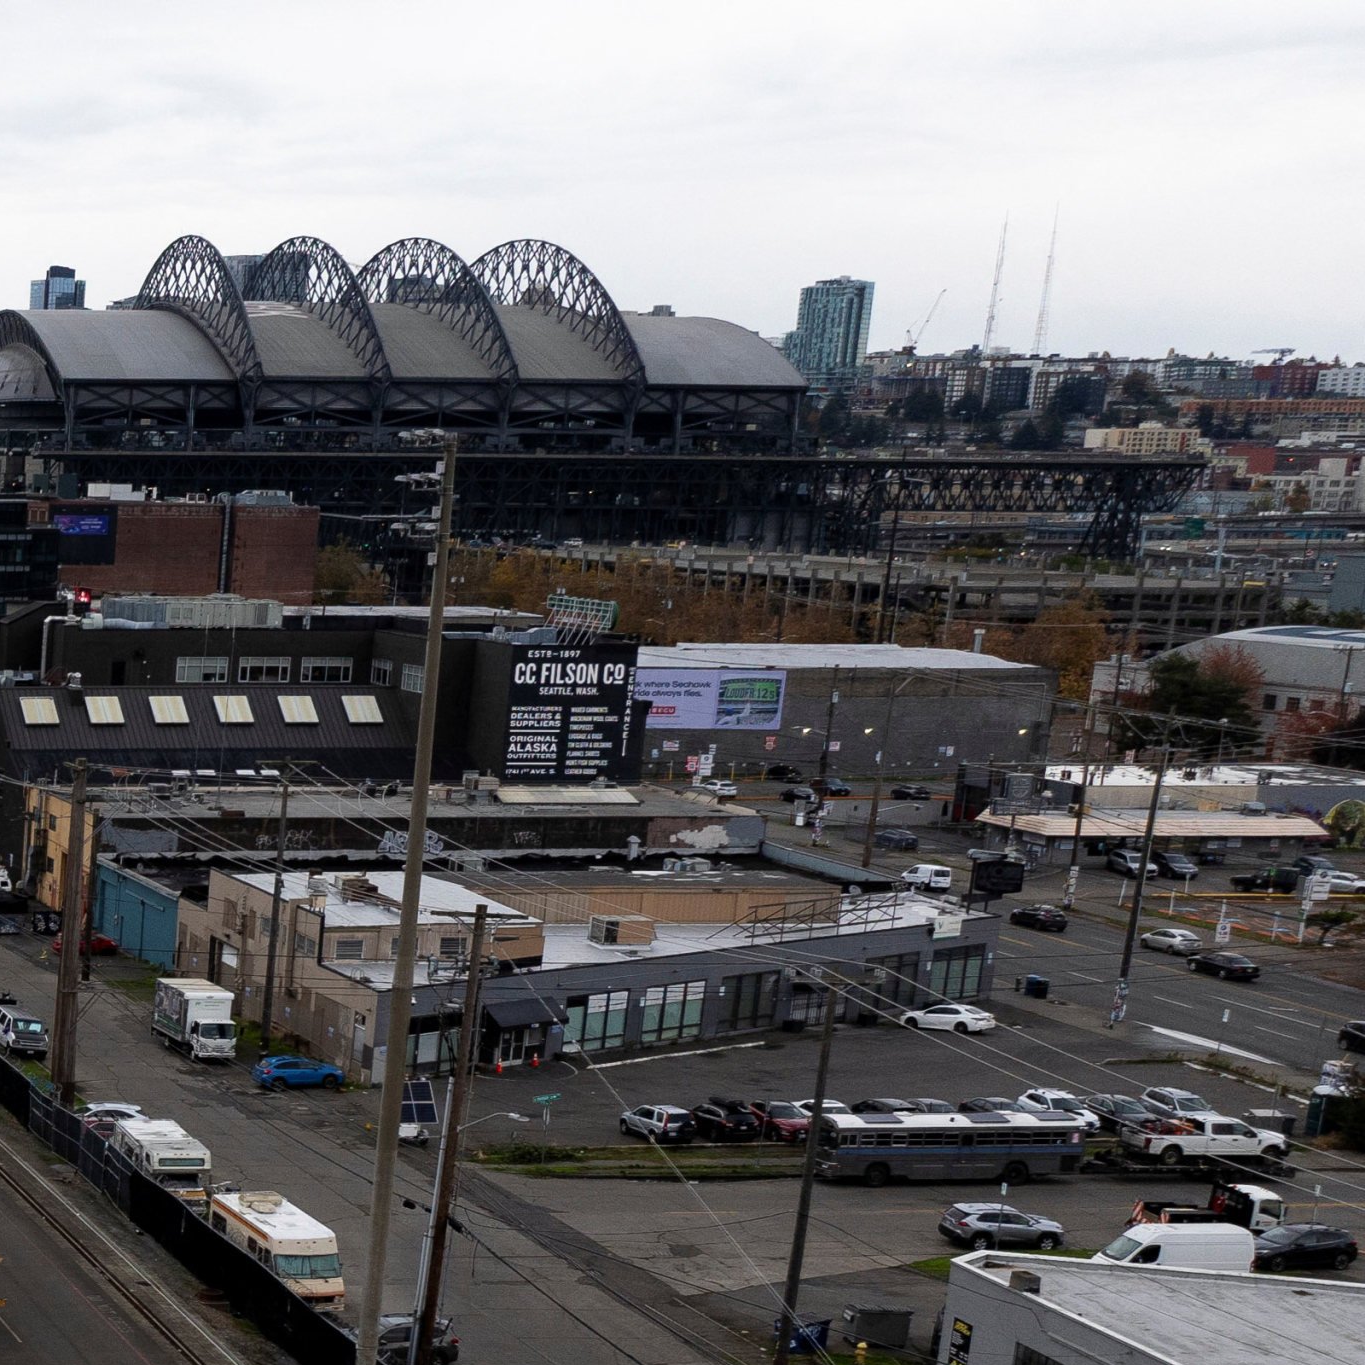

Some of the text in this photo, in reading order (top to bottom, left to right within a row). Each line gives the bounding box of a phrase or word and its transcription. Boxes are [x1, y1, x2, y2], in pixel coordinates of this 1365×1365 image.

[540, 662, 598, 684] FILSON
[539, 686, 600, 696] SEATTLE, WASH.
[651, 690, 682, 698] always
[622, 676, 636, 739] ENTRANCE
[510, 712, 562, 720] DEALERS &
[509, 735, 559, 743] ORIGINAL
[508, 743, 557, 753] ALASKA
[506, 752, 557, 760] OUTFITTERS
